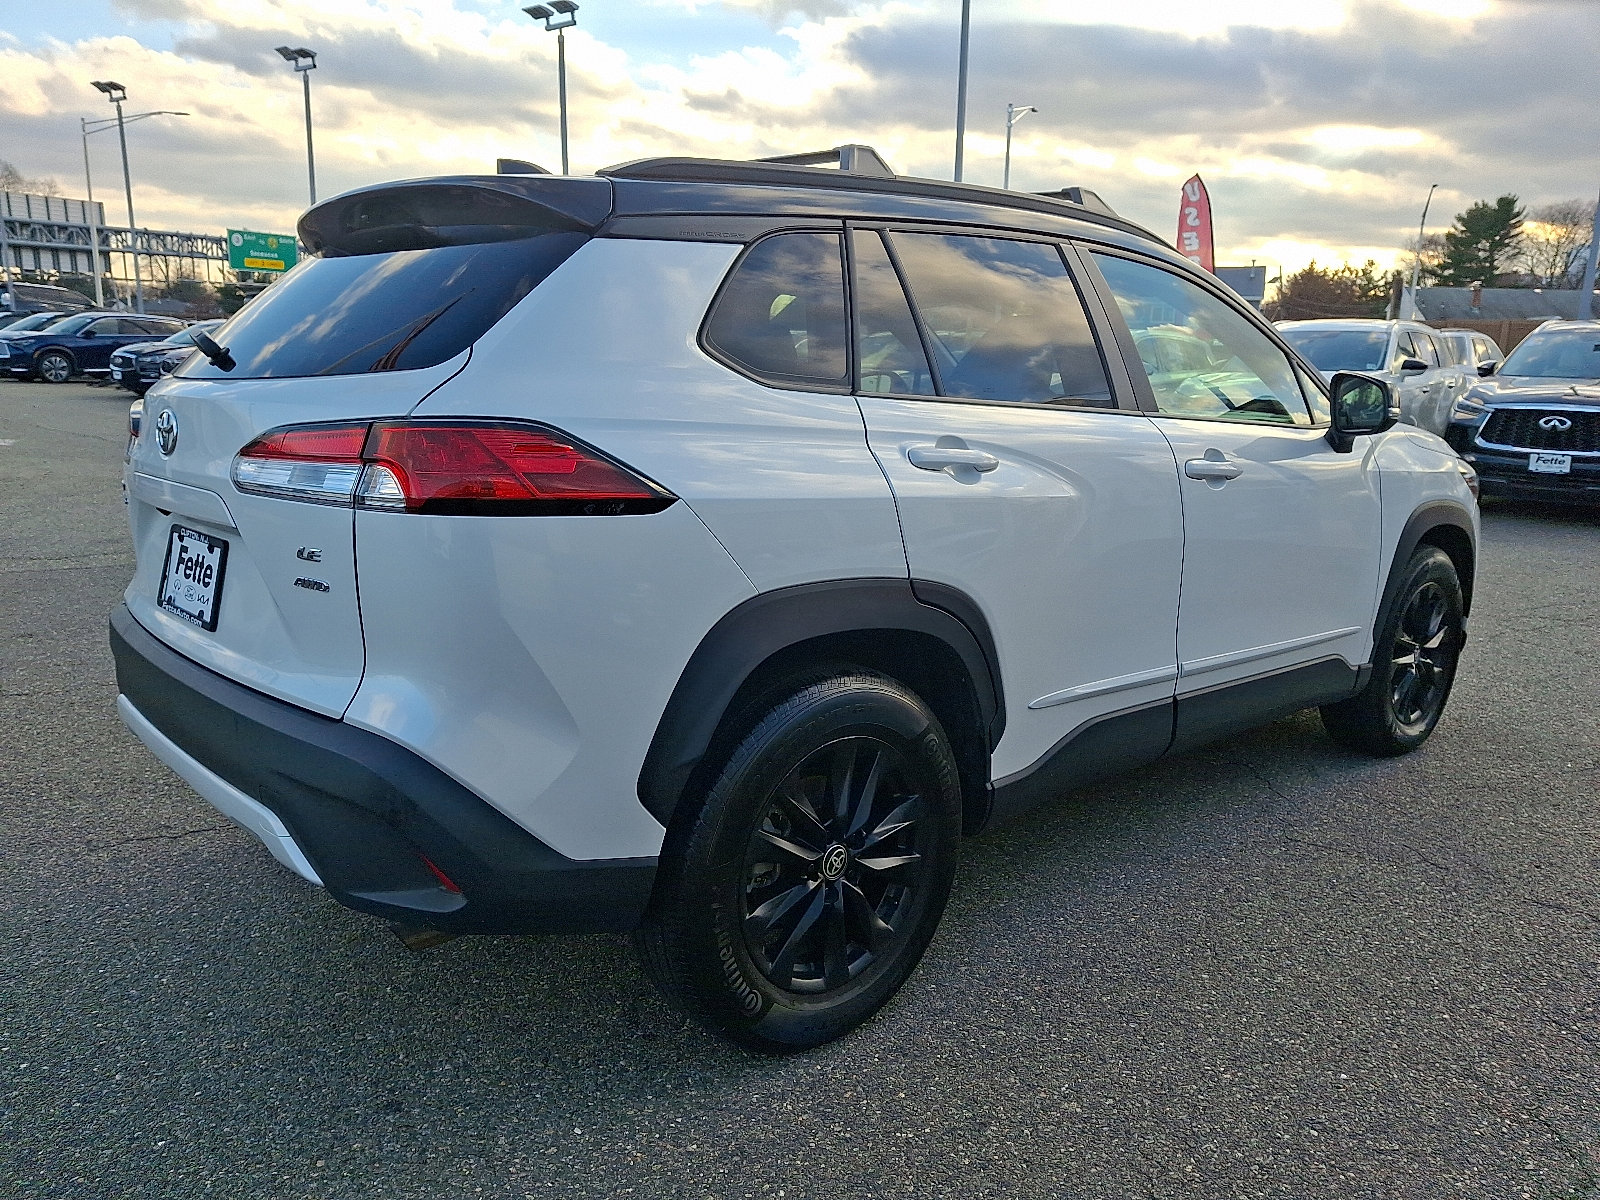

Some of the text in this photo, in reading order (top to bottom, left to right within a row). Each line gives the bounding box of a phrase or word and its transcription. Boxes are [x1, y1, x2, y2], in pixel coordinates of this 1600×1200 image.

[1535, 456, 1566, 466] Fette
[296, 546, 323, 563] LE
[175, 544, 213, 588] Fette
